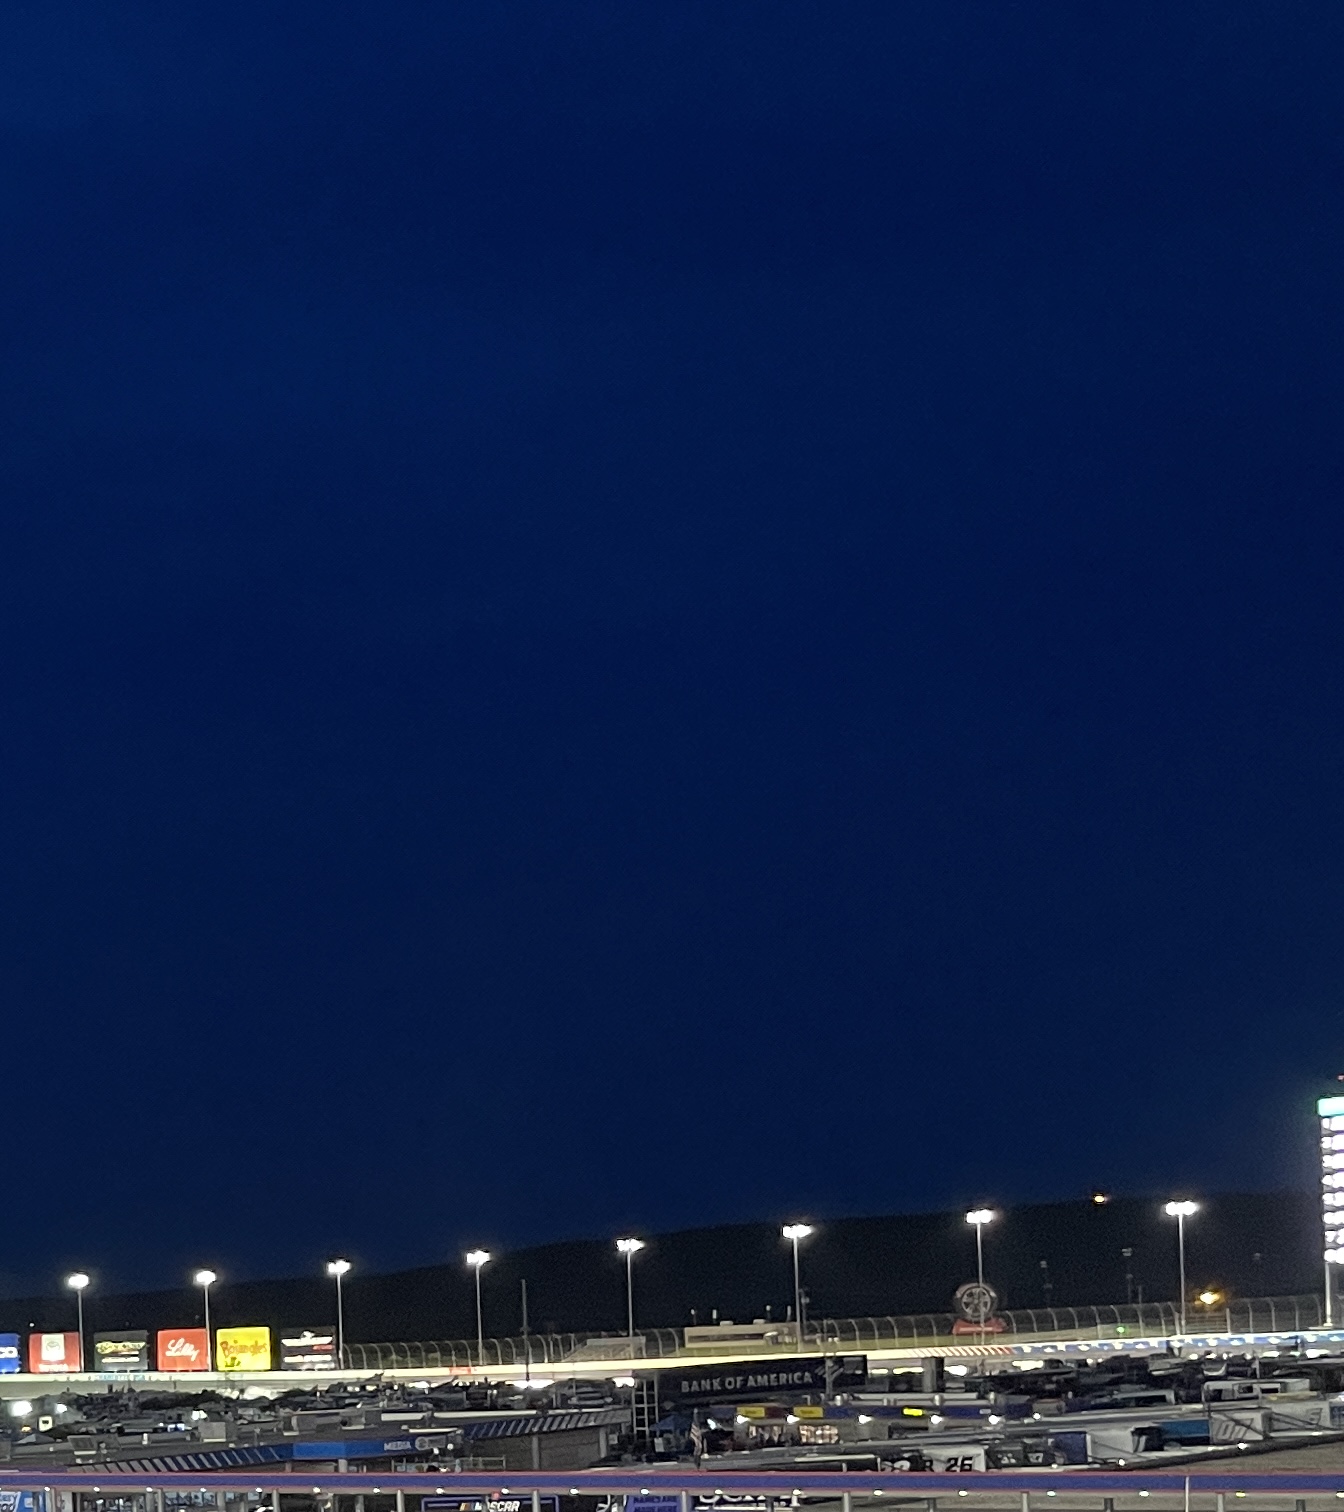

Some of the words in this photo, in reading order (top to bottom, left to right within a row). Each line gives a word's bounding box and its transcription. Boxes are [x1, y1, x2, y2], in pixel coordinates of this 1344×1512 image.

[165, 1338, 199, 1361] Lilly
[681, 1377, 720, 1393] BANK
[725, 1375, 744, 1390] OF
[745, 1371, 812, 1388] AMERICA
[384, 1440, 411, 1452] MEDIA
[474, 1500, 520, 1512] NSCAR
